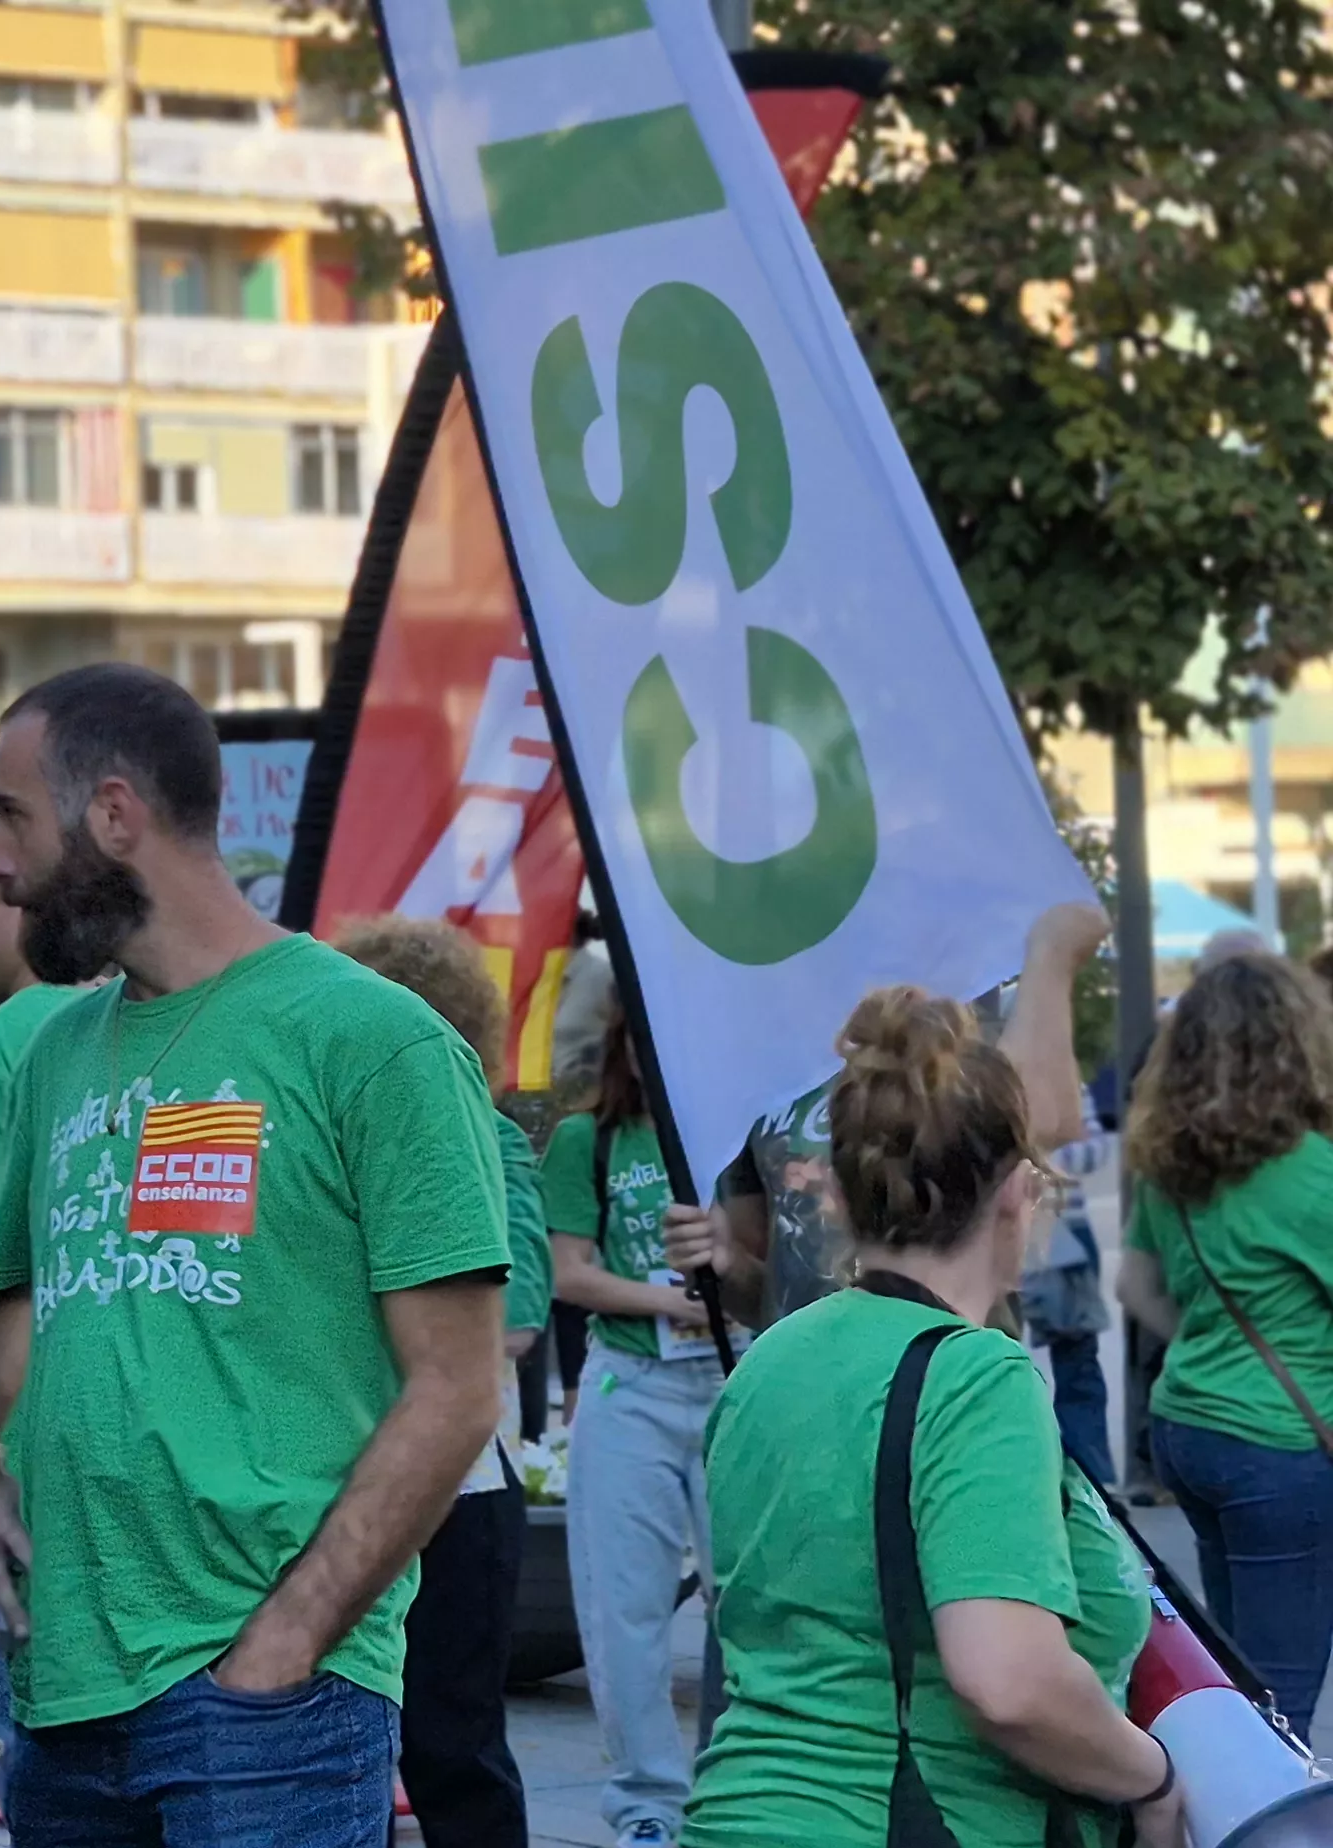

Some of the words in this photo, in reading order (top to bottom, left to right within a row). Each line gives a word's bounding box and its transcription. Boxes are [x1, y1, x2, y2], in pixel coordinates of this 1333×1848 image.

[138, 1153, 253, 1184] CCOO
[137, 1182, 248, 1204] enseñanza
[50, 1195, 82, 1241] DE
[623, 1210, 657, 1235] DE
